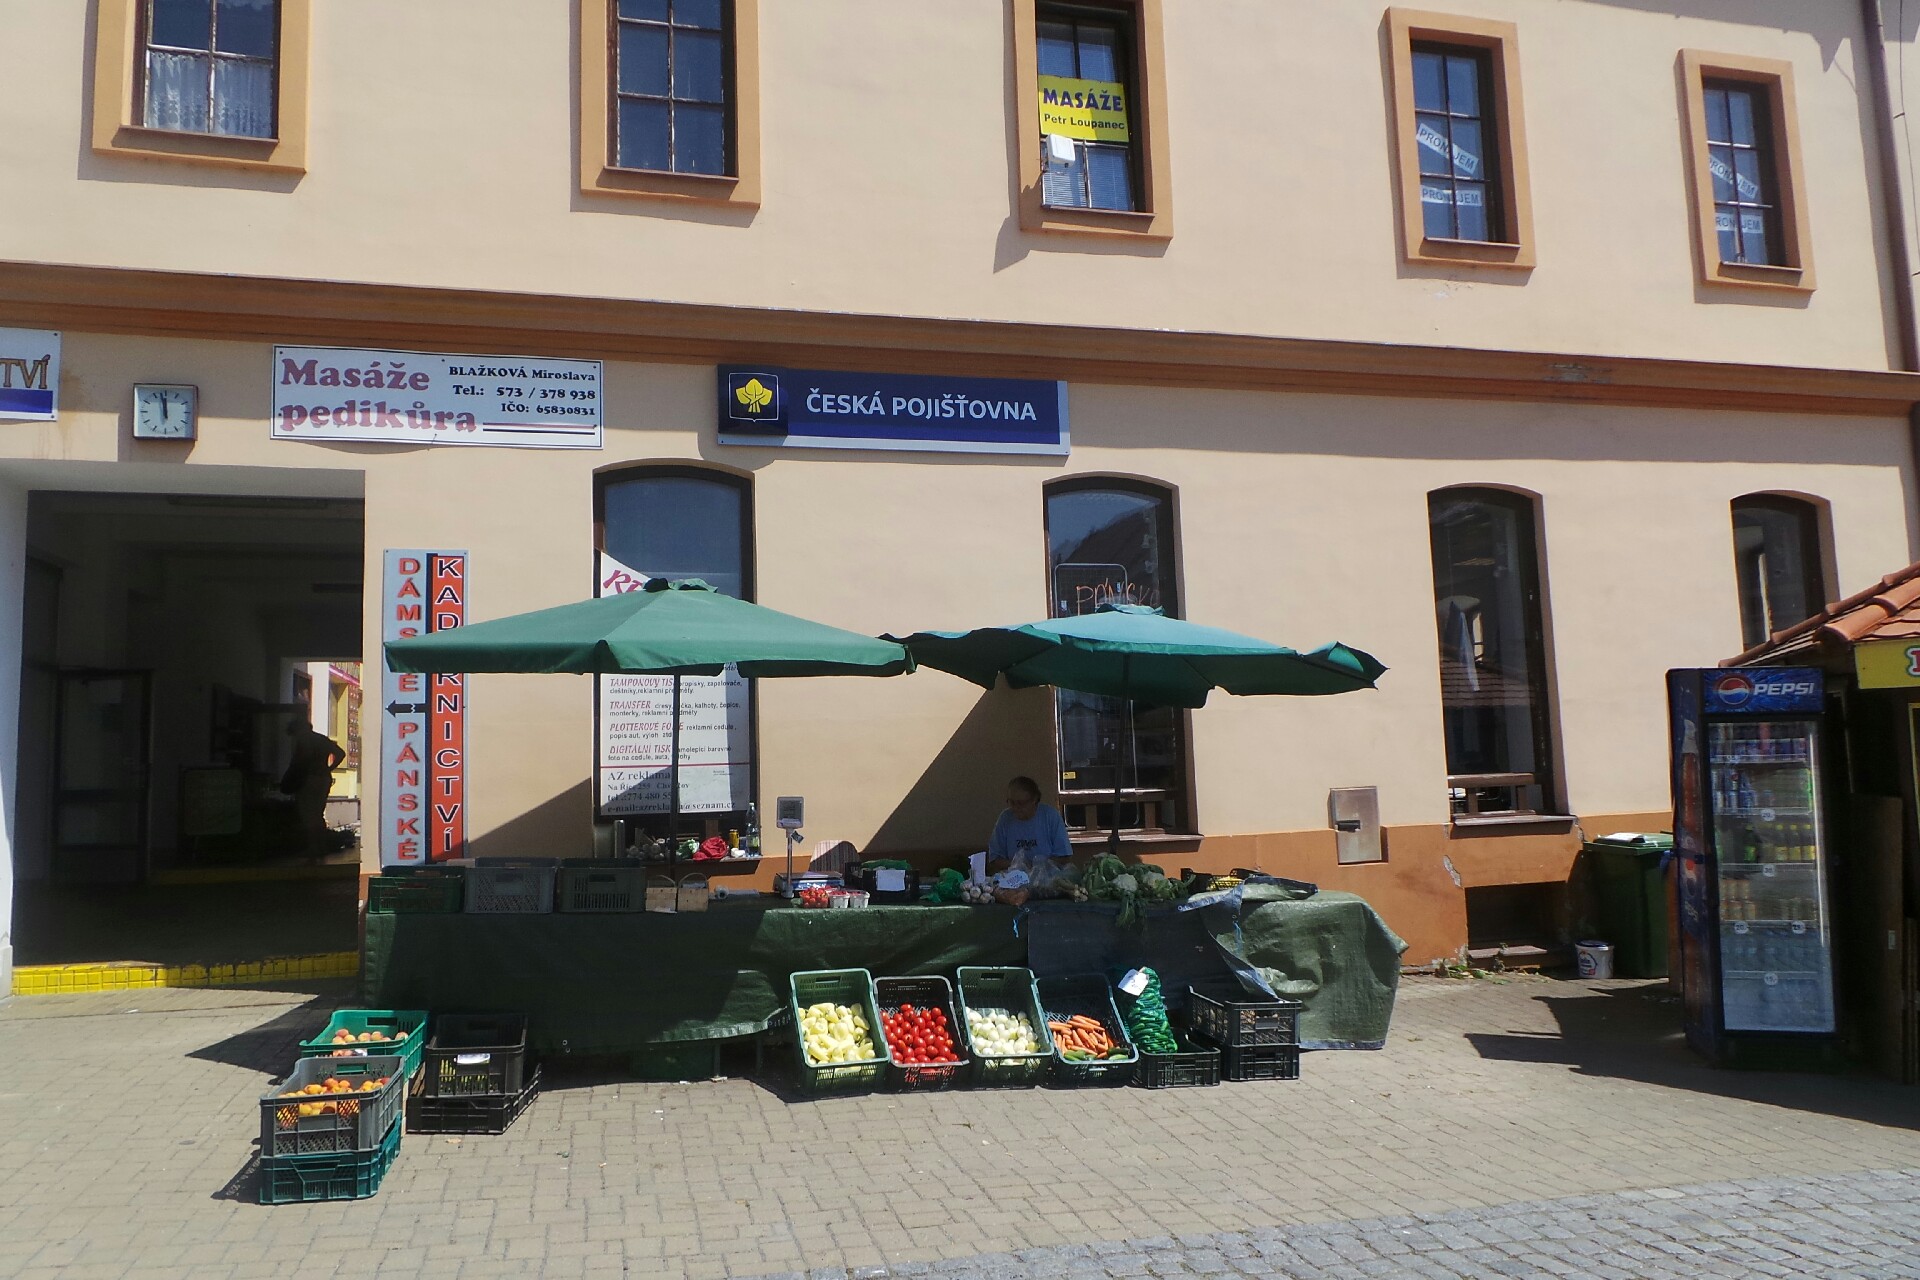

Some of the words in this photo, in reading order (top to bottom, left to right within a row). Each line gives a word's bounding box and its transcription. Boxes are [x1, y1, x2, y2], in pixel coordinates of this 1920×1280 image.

[1043, 88, 1124, 112] MASÁŽE
[1044, 113, 1067, 125] Petr
[1070, 117, 1125, 130] Loupanec
[1419, 128, 1476, 171] PRONJEM
[1422, 188, 1479, 204] PRONJEM
[1716, 216, 1761, 231] RONJEM
[281, 358, 430, 392] Masáže
[449, 365, 528, 378] BLAŽKOVÁ
[532, 369, 595, 381] Miroslava
[453, 385, 484, 396] Tel.:
[496, 387, 523, 397] 573
[539, 389, 565, 399] 378
[570, 390, 595, 400] 938
[501, 401, 529, 413] IČO:
[536, 404, 595, 416] 65830831
[806, 388, 885, 416] ČESKÁ
[892, 396, 1037, 421] POJIŠŤOVNA
[280, 400, 477, 434] pedikůra
[396, 557, 422, 692] DÁMSÉ
[1753, 682, 1815, 696] PEPSI
[435, 558, 462, 852] KADNICTVÍ
[610, 701, 651, 709] TRANSFER
[655, 745, 671, 753] TISK
[608, 771, 625, 780] AZ
[396, 722, 421, 862] PÁNSKÉ
